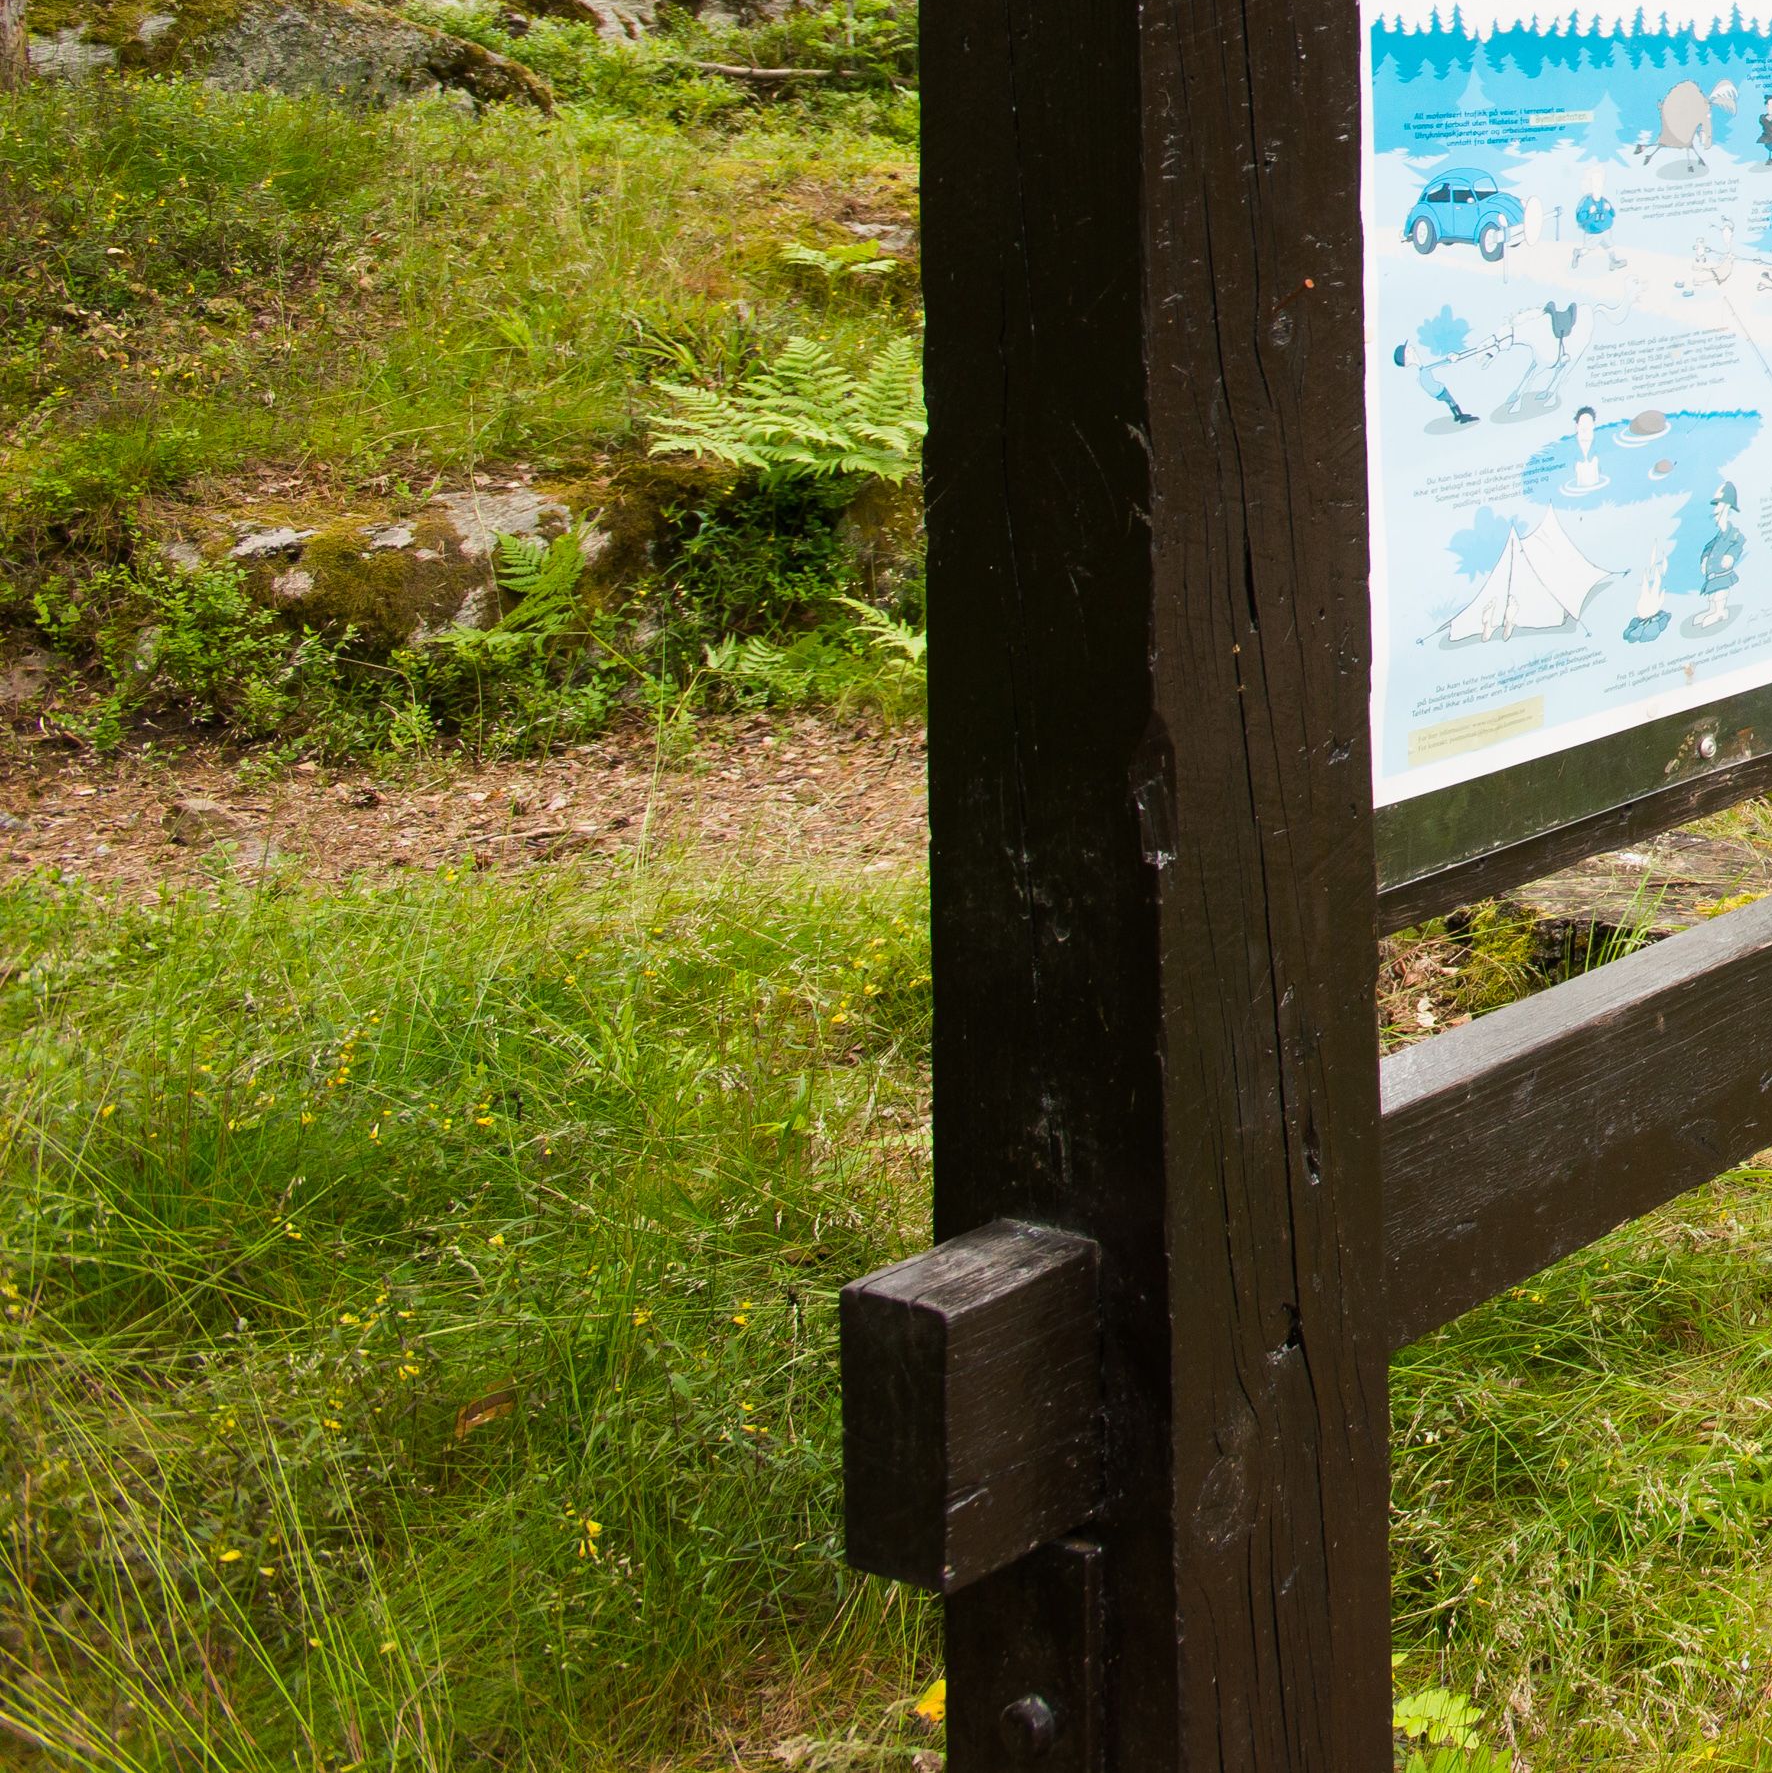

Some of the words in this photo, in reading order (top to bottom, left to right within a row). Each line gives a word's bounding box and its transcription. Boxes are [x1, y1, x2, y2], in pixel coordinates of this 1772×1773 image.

[1426, 111, 1462, 120] motorisert
[1464, 110, 1487, 119] trafikk
[1488, 108, 1499, 117] på
[1445, 120, 1469, 130] forbudt
[1520, 117, 1530, 125] fra
[1446, 139, 1472, 147] unntatt
[1474, 138, 1485, 146] fra
[1487, 137, 1508, 145] denne
[1438, 474, 1452, 482] kan
[1453, 472, 1472, 481] bade
[1479, 467, 1494, 476] alle
[1496, 464, 1514, 473] elver
[1435, 493, 1459, 503] Samme
[1483, 484, 1510, 495] gjelder
[1440, 482, 1463, 493] belagt
[1465, 479, 1482, 487] med
[1436, 685, 1445, 693] Du
[1447, 682, 1461, 691] kan
[1462, 677, 1479, 687] telte
[1480, 674, 1496, 683] hvor
[1412, 707, 1431, 717] Teltet
[1433, 702, 1444, 712] må
[1445, 699, 1460, 708] ikke
[1463, 695, 1475, 705] stå
[1476, 693, 1489, 701] mer
[1490, 689, 1503, 697] enn
[1417, 699, 1428, 708] på
[1480, 681, 1497, 691] eller
